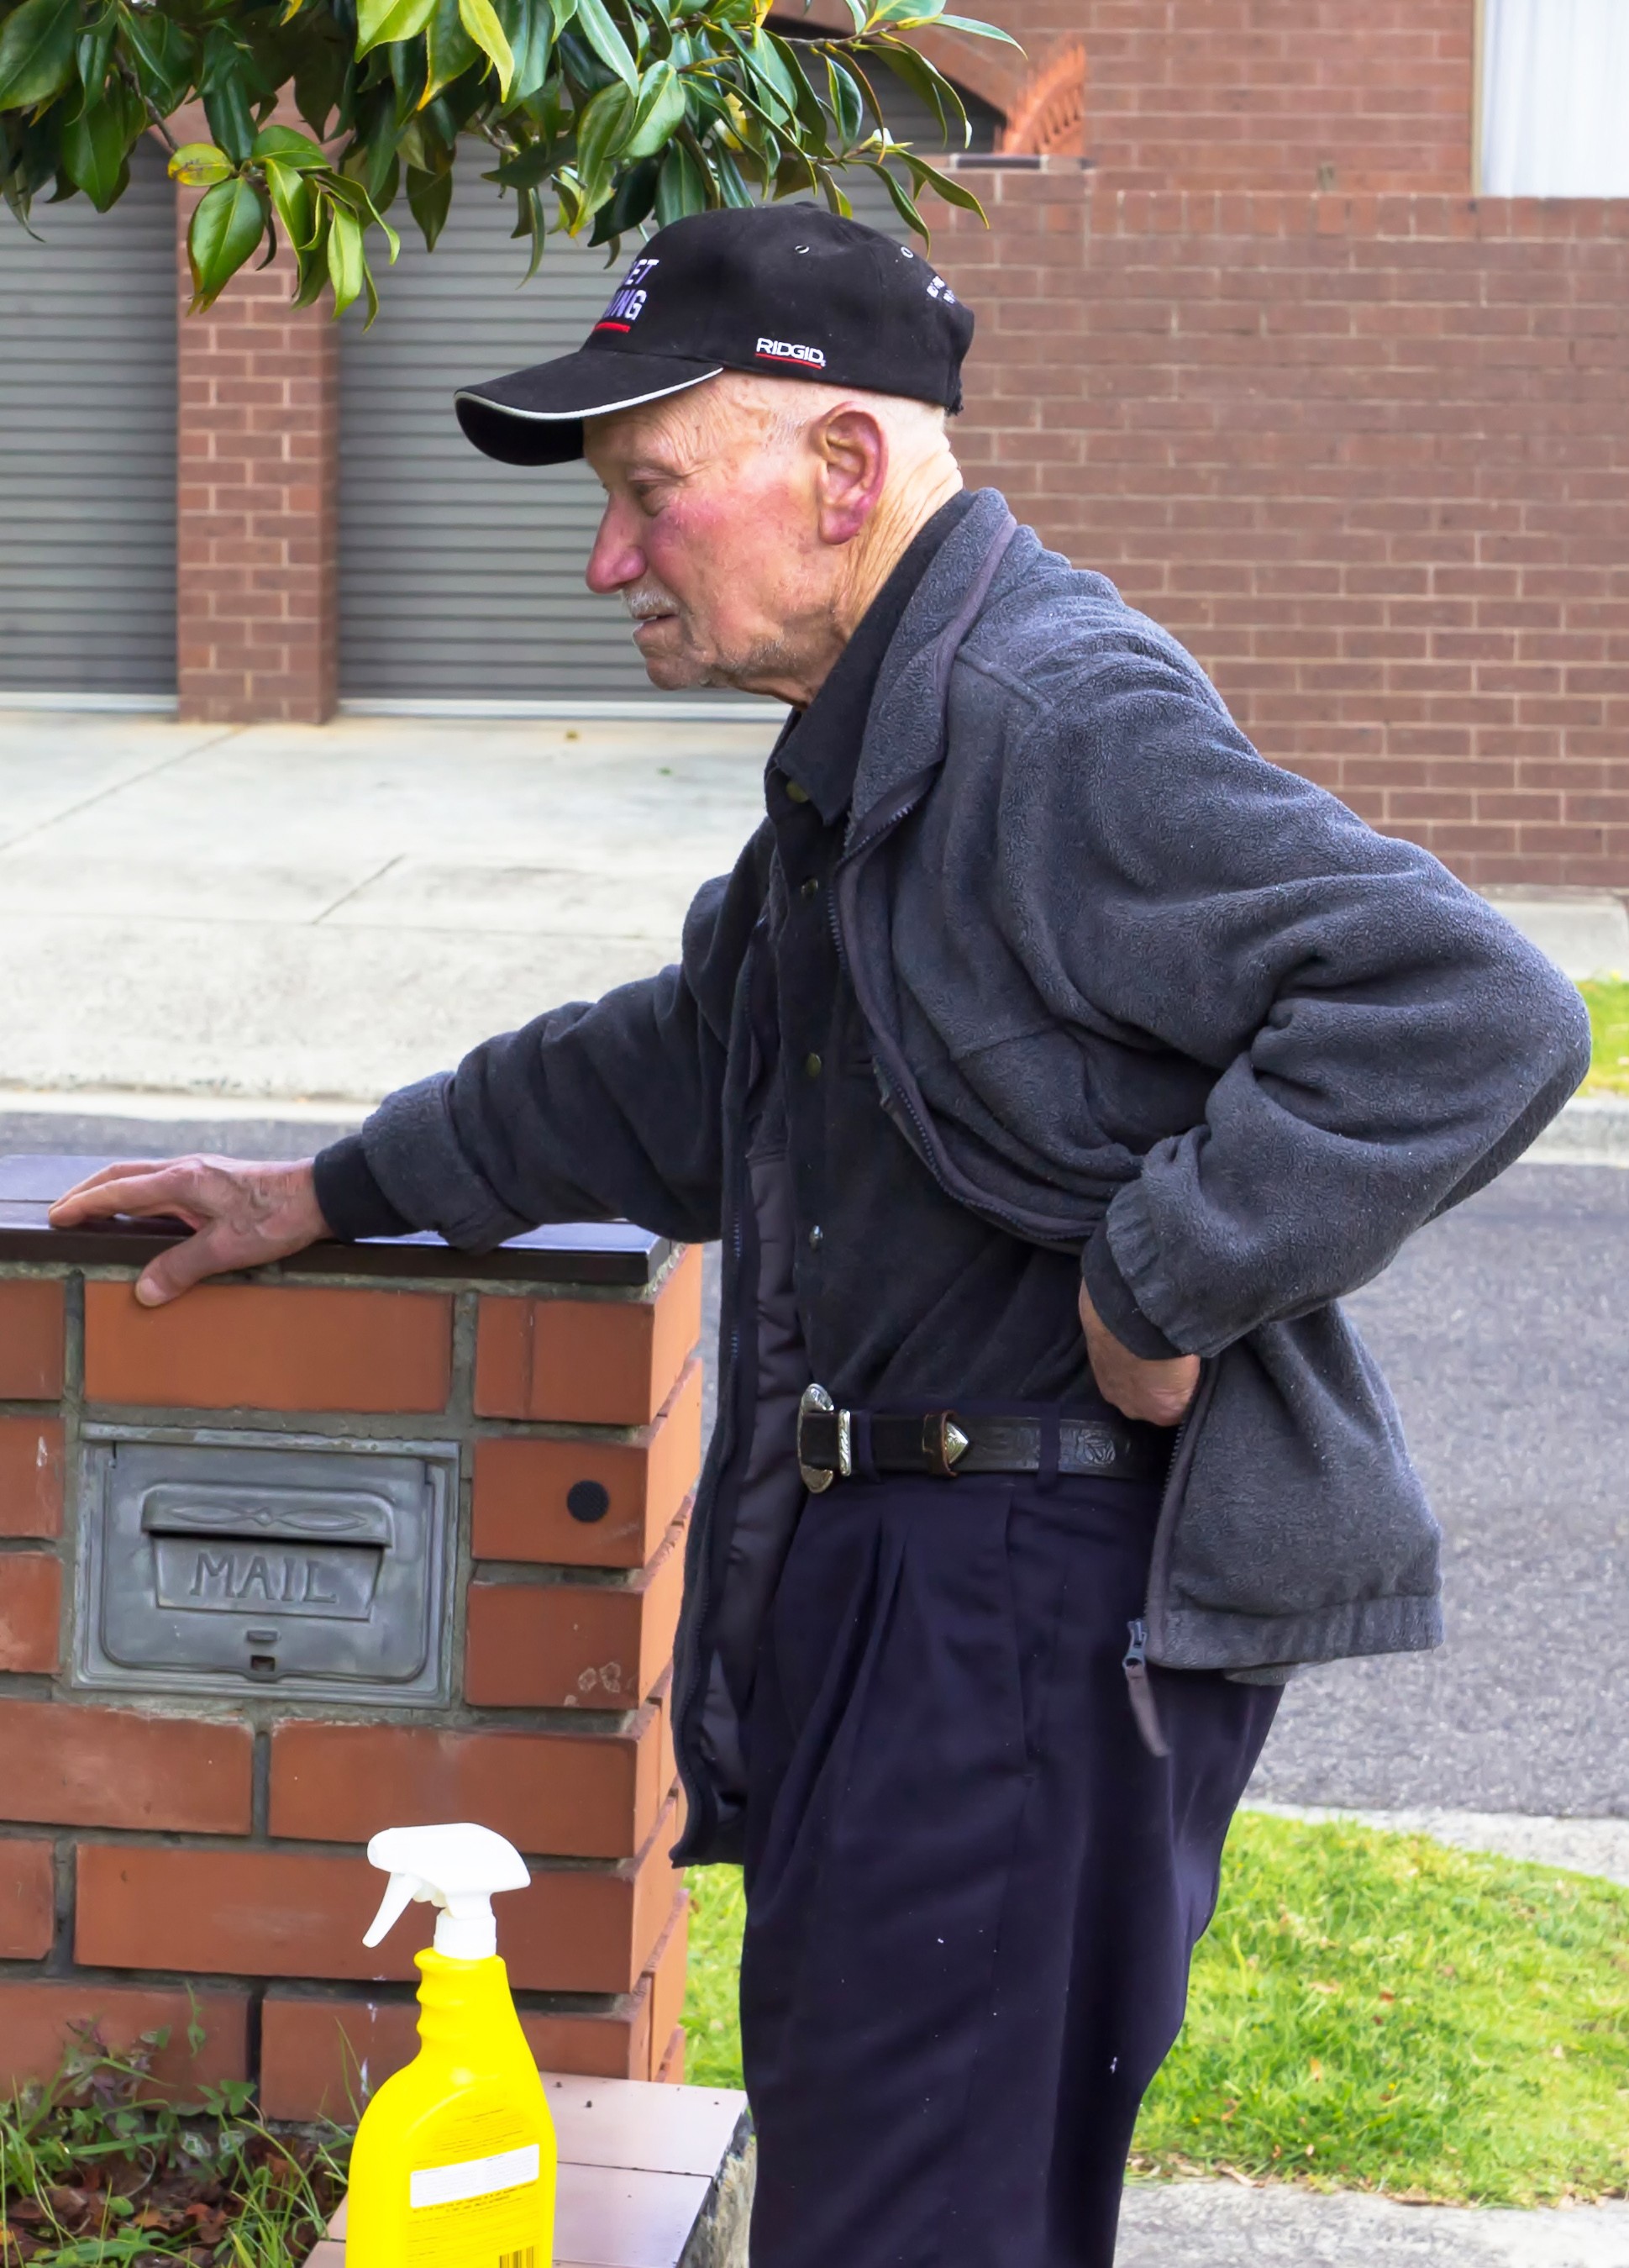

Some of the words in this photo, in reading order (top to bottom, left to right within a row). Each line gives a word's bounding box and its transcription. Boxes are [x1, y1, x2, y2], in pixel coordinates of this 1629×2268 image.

[624, 259, 659, 285] ET
[756, 337, 824, 364] RIDGID
[189, 1552, 337, 1604] MAIL
